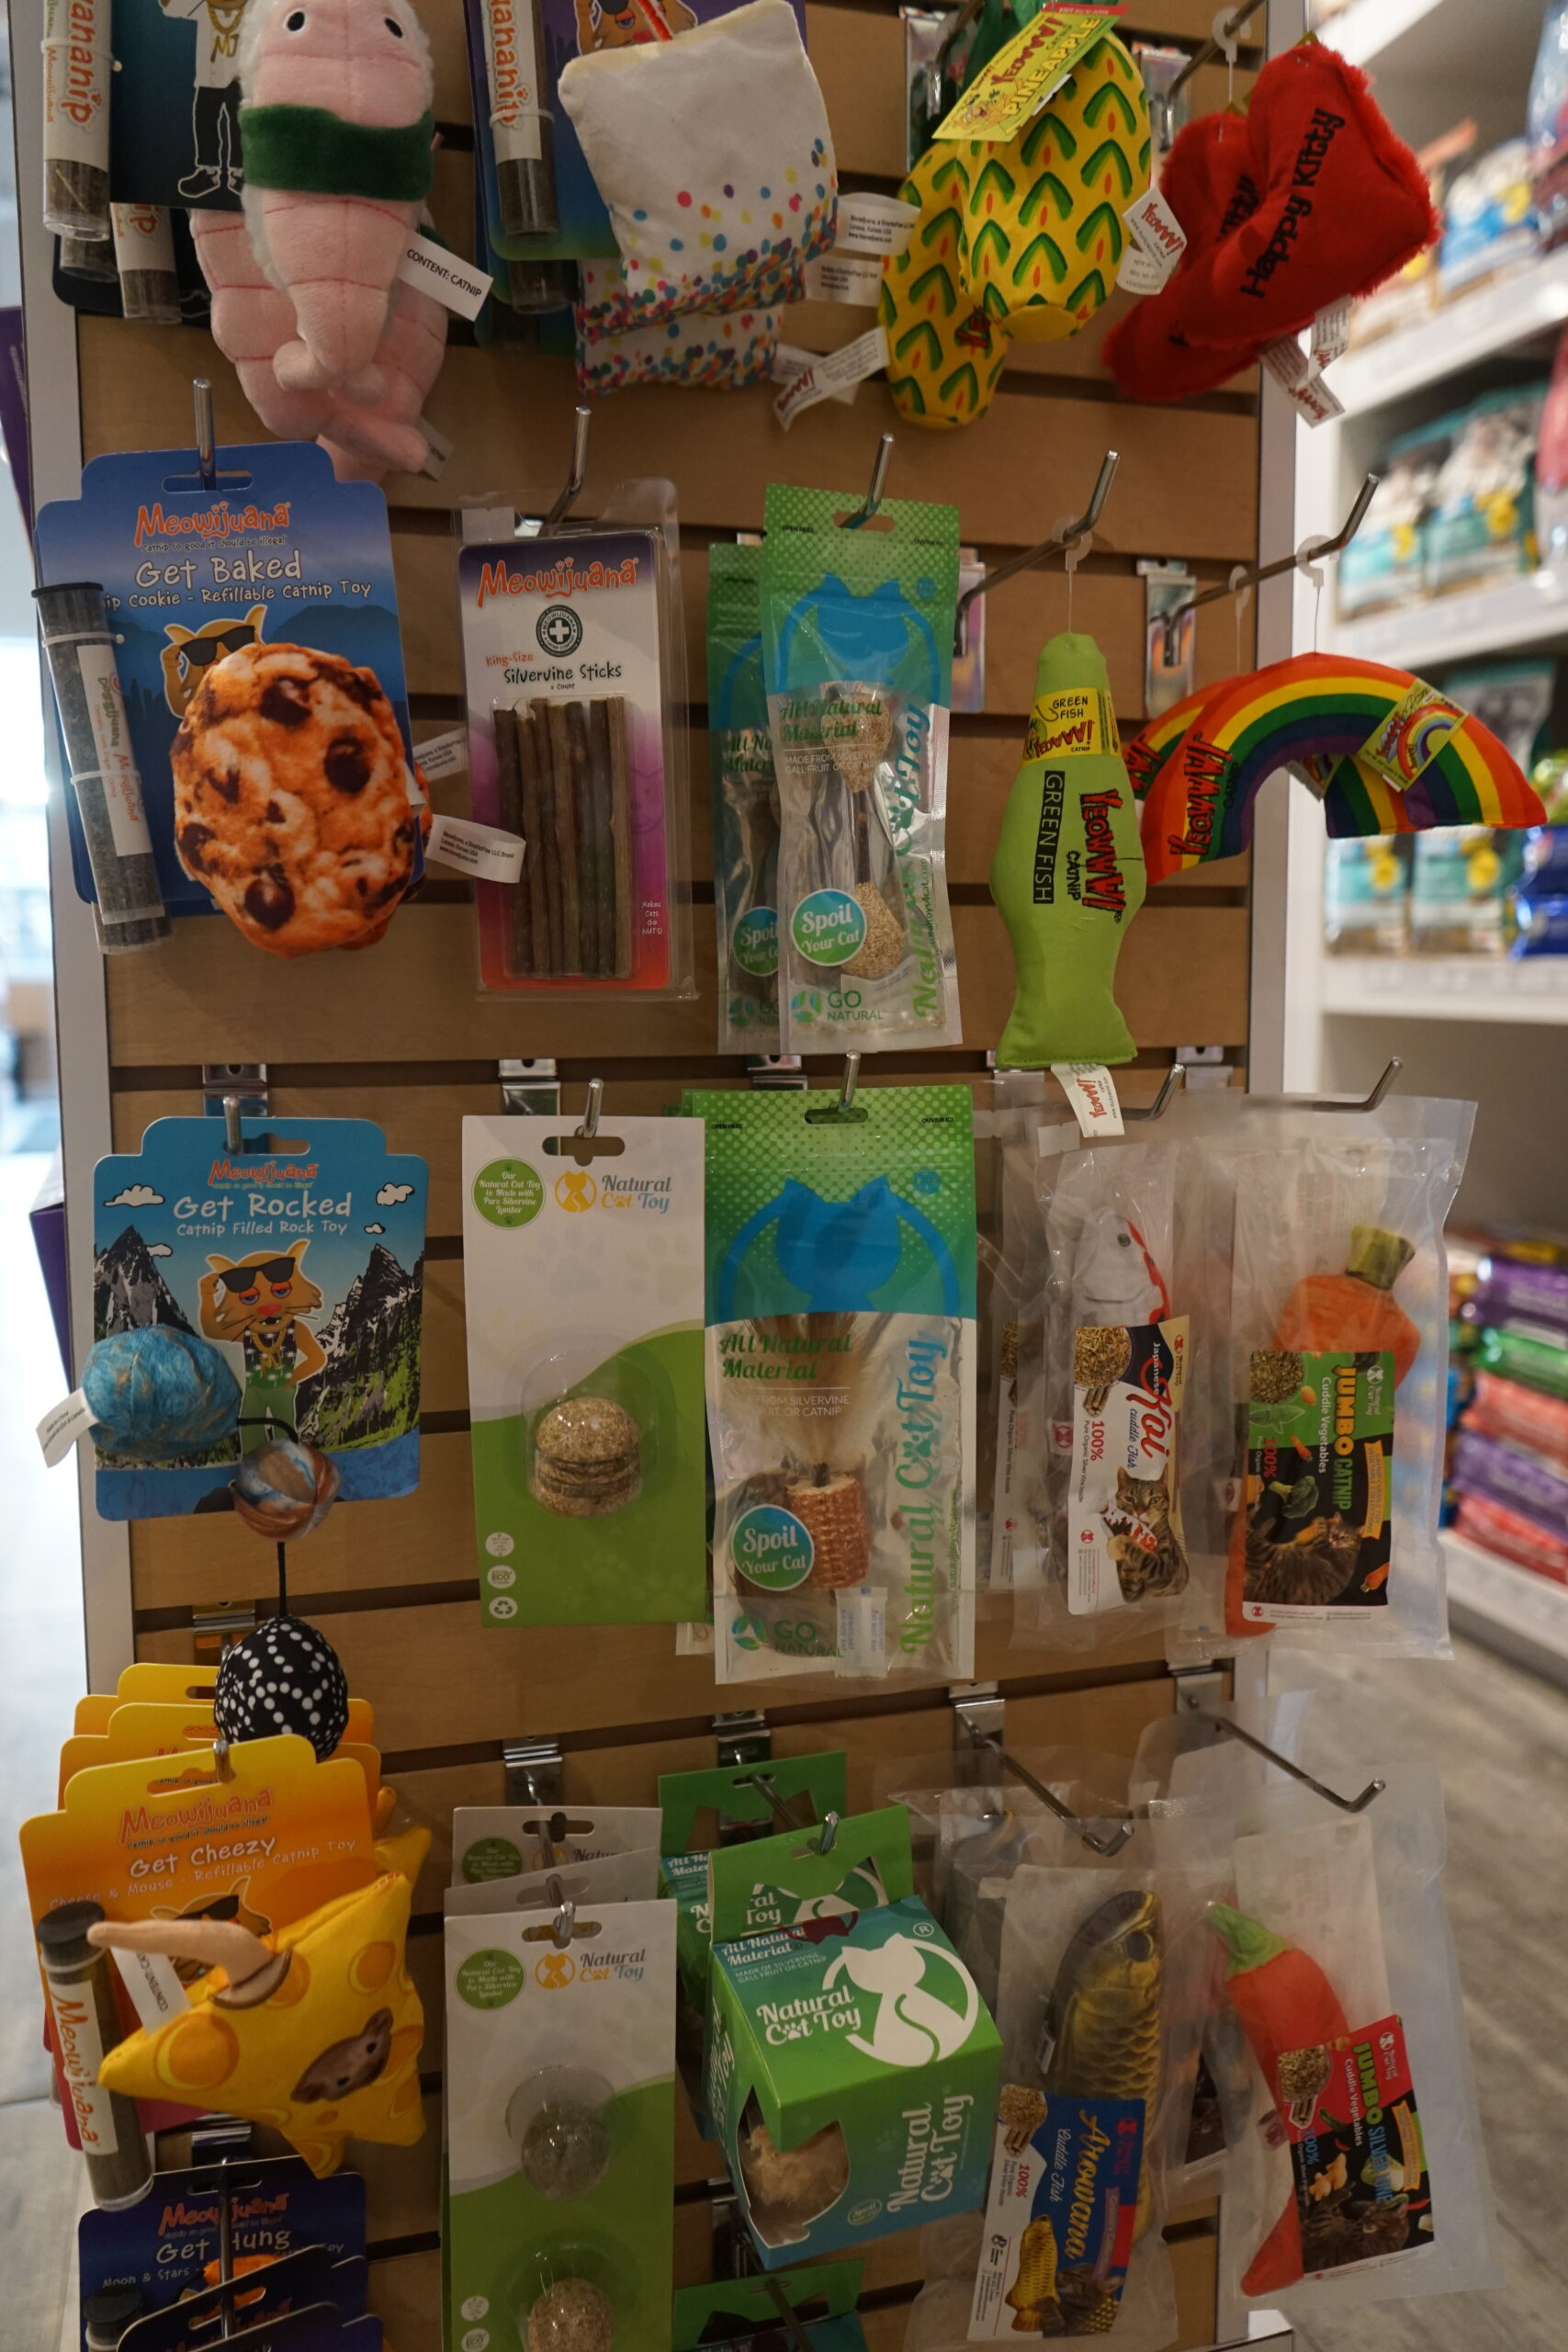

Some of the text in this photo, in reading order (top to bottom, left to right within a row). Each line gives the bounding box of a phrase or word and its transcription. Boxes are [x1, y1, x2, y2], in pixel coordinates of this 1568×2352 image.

[1002, 18, 1100, 117] PINEAPPLE
[1240, 194, 1313, 298] Happy
[1294, 108, 1346, 187] Kitty
[407, 249, 482, 297] CONTENT: CATNIP
[134, 502, 291, 547] Meowijuana
[135, 548, 301, 589] Get Baked
[477, 557, 639, 608] Meowijuana
[129, 590, 180, 608] Cookie
[200, 585, 276, 603] Refillable
[282, 582, 333, 599] Catnip
[338, 579, 372, 599] Toy
[503, 662, 622, 684] Silvervine Sticks
[1053, 696, 1088, 709] GREEN
[1060, 708, 1084, 719] FISH
[1168, 739, 1234, 855] YEOWWW!
[1034, 774, 1062, 902] GREEN FISH
[1078, 788, 1127, 915] YEOWWW!
[1066, 851, 1081, 902] CATNIP
[801, 903, 853, 934] Spoil
[801, 929, 860, 956] Your Cat
[827, 989, 862, 1010] GO
[827, 1010, 884, 1023] NATURAL
[208, 1159, 319, 1187] Meowijuana
[601, 1174, 672, 1193] Natural
[173, 1190, 353, 1223] Get Rocked
[637, 1193, 671, 1215] Toy
[176, 1219, 348, 1238] Catnip Filled Rock Toy
[720, 1333, 852, 1353] All Natural
[723, 1358, 818, 1380] Material
[896, 1339, 945, 1411] Toy
[1153, 1342, 1161, 1396] Japanese
[784, 1408, 842, 1418] OR CATNIP
[790, 1395, 851, 1406] SILVERVINE
[1089, 1420, 1105, 1462] 100%
[1127, 1408, 1138, 1469] cuddle Fish
[1317, 1376, 1332, 1473] Cuddle Vegetables
[1332, 1366, 1355, 1510] JUMBO CATNIP
[1263, 1438, 1277, 1477] 100%
[742, 1523, 798, 1553] Spoil
[741, 1554, 807, 1577] Your Cat
[897, 1500, 934, 1652] Natural
[774, 1620, 818, 1641] GO
[118, 1788, 273, 1845] Meowijuana
[129, 1879, 174, 1895] Mouse
[194, 1858, 265, 1883] Refillable
[272, 1847, 319, 1867] Catnip
[326, 1838, 356, 1852] Toy
[130, 1836, 277, 1878] Get Cheezy
[581, 1949, 647, 1967] Natural
[721, 1943, 746, 1956] All
[727, 1941, 793, 1966] Material
[614, 1964, 645, 1982] Toy
[756, 1984, 855, 2025] Natural
[813, 2007, 862, 2031] Toy
[1344, 2058, 1363, 2146] Cuddle Vegetables
[1352, 2041, 1382, 2124] JUMBO
[1367, 2125, 1391, 2174] SILVER
[930, 2094, 974, 2158] Toy
[886, 2101, 931, 2213] Natural
[1304, 2129, 1321, 2165] 100%
[1016, 2164, 1031, 2199] 100%
[1050, 2128, 1071, 2203] Cuddle Fish
[1066, 2109, 1111, 2259] Arowana
[156, 2238, 210, 2264] Get
[158, 2267, 190, 2280] Stars
